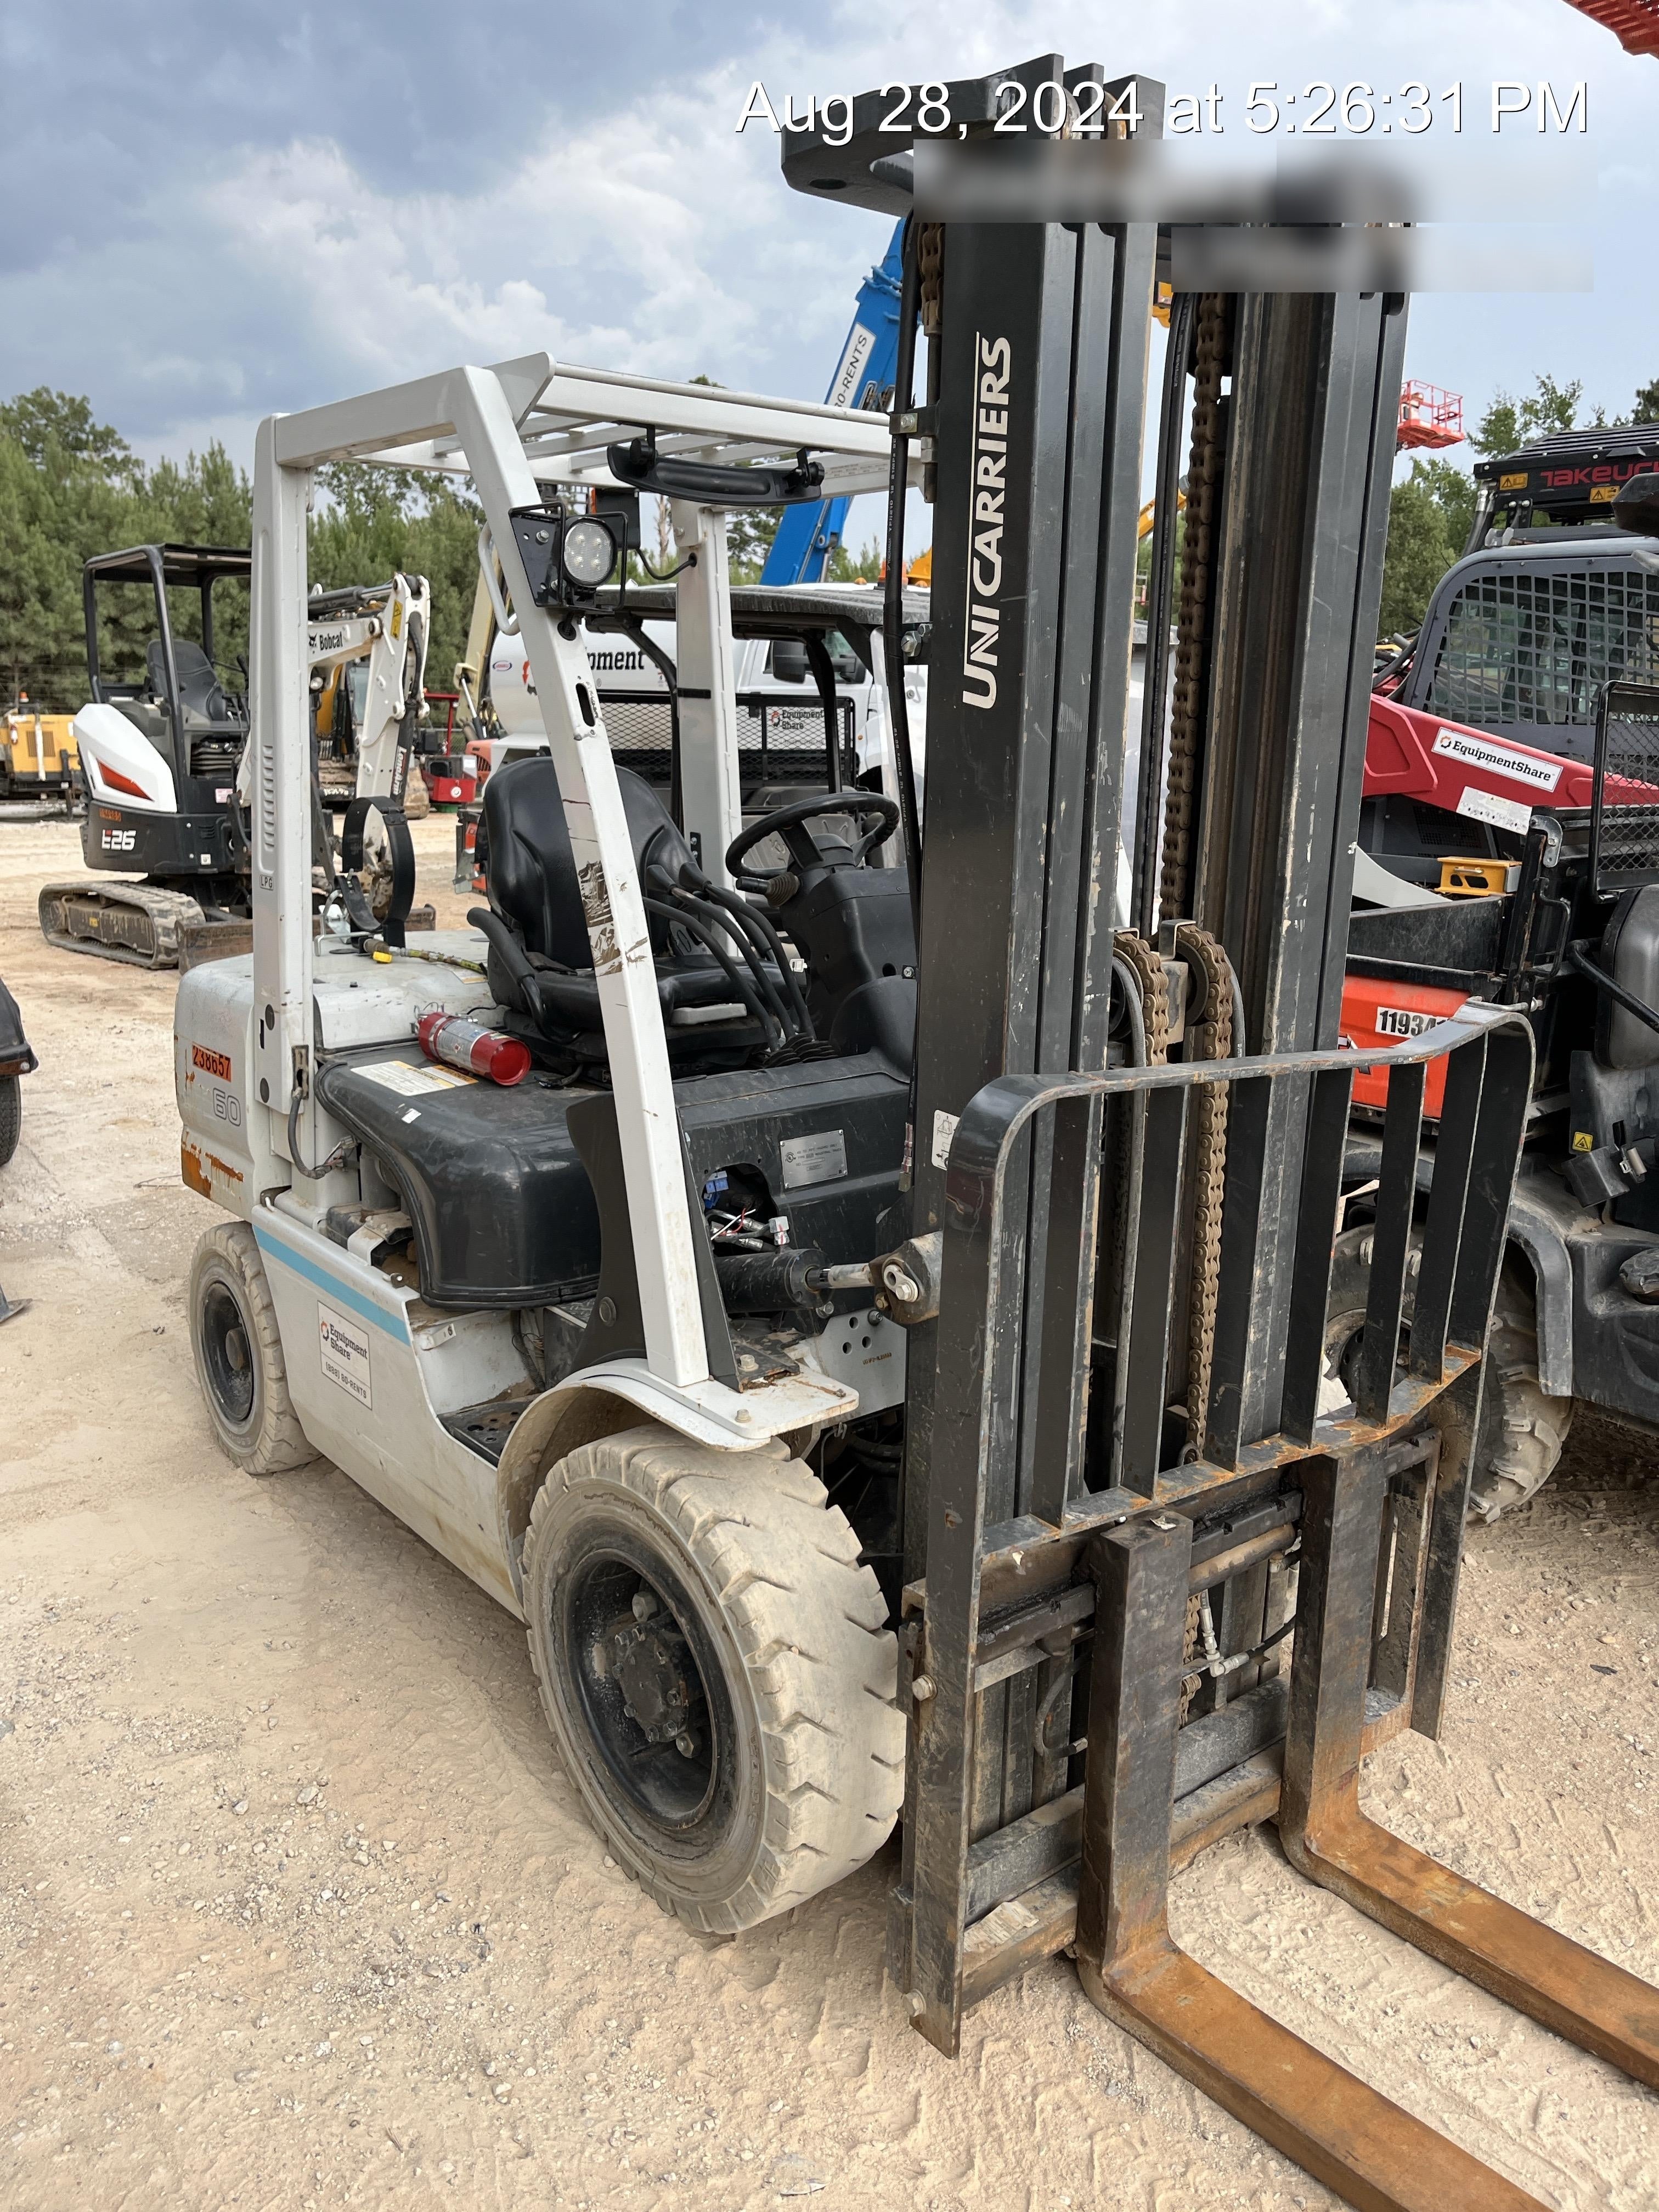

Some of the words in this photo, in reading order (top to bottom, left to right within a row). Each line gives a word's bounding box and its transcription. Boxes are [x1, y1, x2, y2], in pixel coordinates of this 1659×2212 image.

[319, 631, 343, 651] Bobcat
[1452, 740, 1551, 781] EquipmentShare
[101, 829, 137, 851] E26
[261, 876, 273, 888] LPG
[1380, 1010, 1449, 1036] 11934
[193, 1045, 231, 1079] 238657
[213, 1087, 241, 1126] 60
[330, 1324, 368, 1359] Equipment
[331, 1338, 351, 1360] Share
[326, 1362, 340, 1379] (888)
[341, 1374, 366, 1398] 80-RENTS
